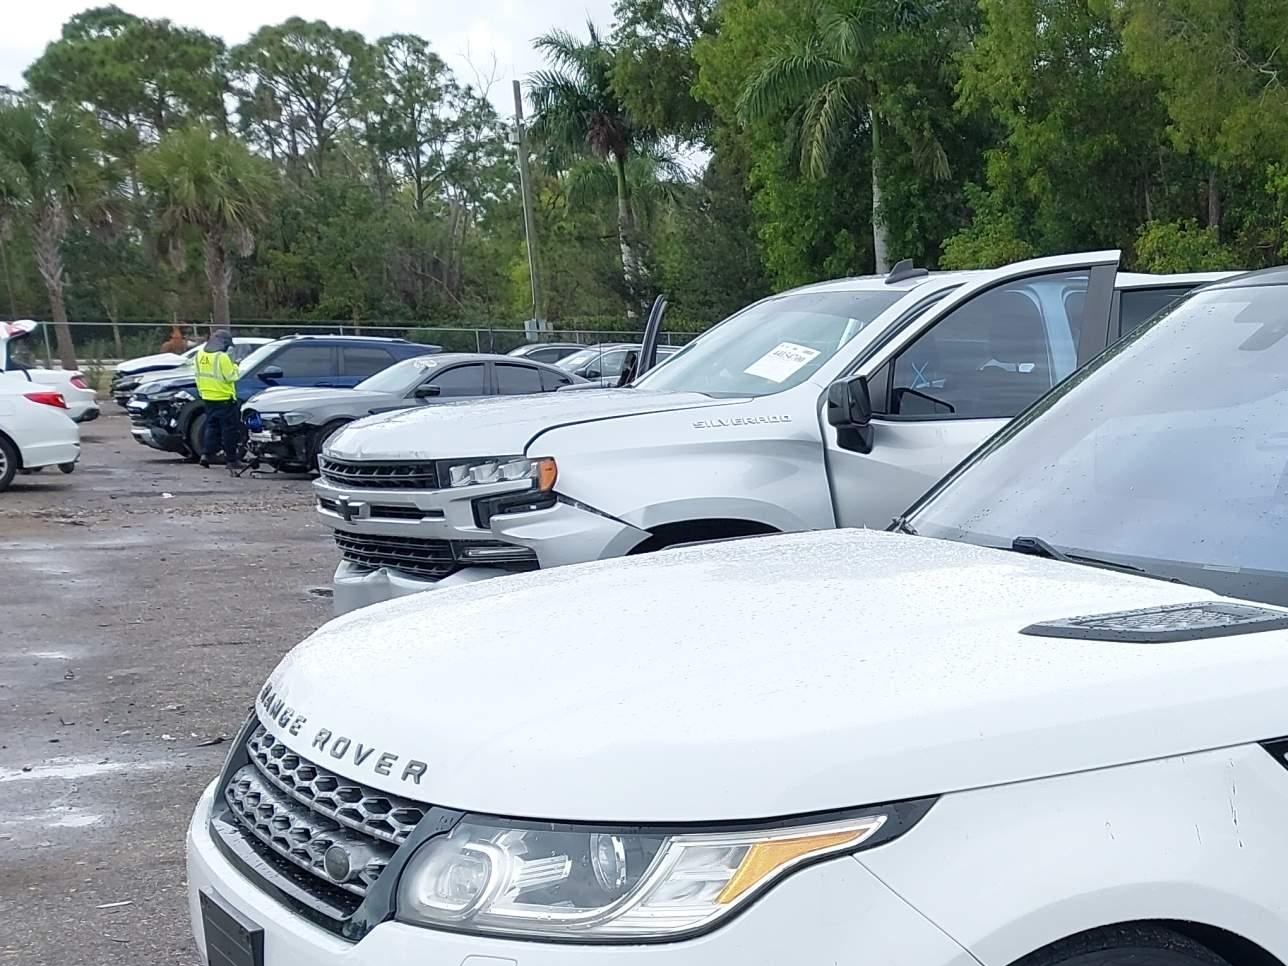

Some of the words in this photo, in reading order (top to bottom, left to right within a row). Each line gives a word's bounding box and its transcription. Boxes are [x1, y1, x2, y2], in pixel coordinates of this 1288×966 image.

[692, 414, 792, 429] SILVERADO
[260, 682, 307, 736] RANGE
[311, 727, 428, 785] ROVER
